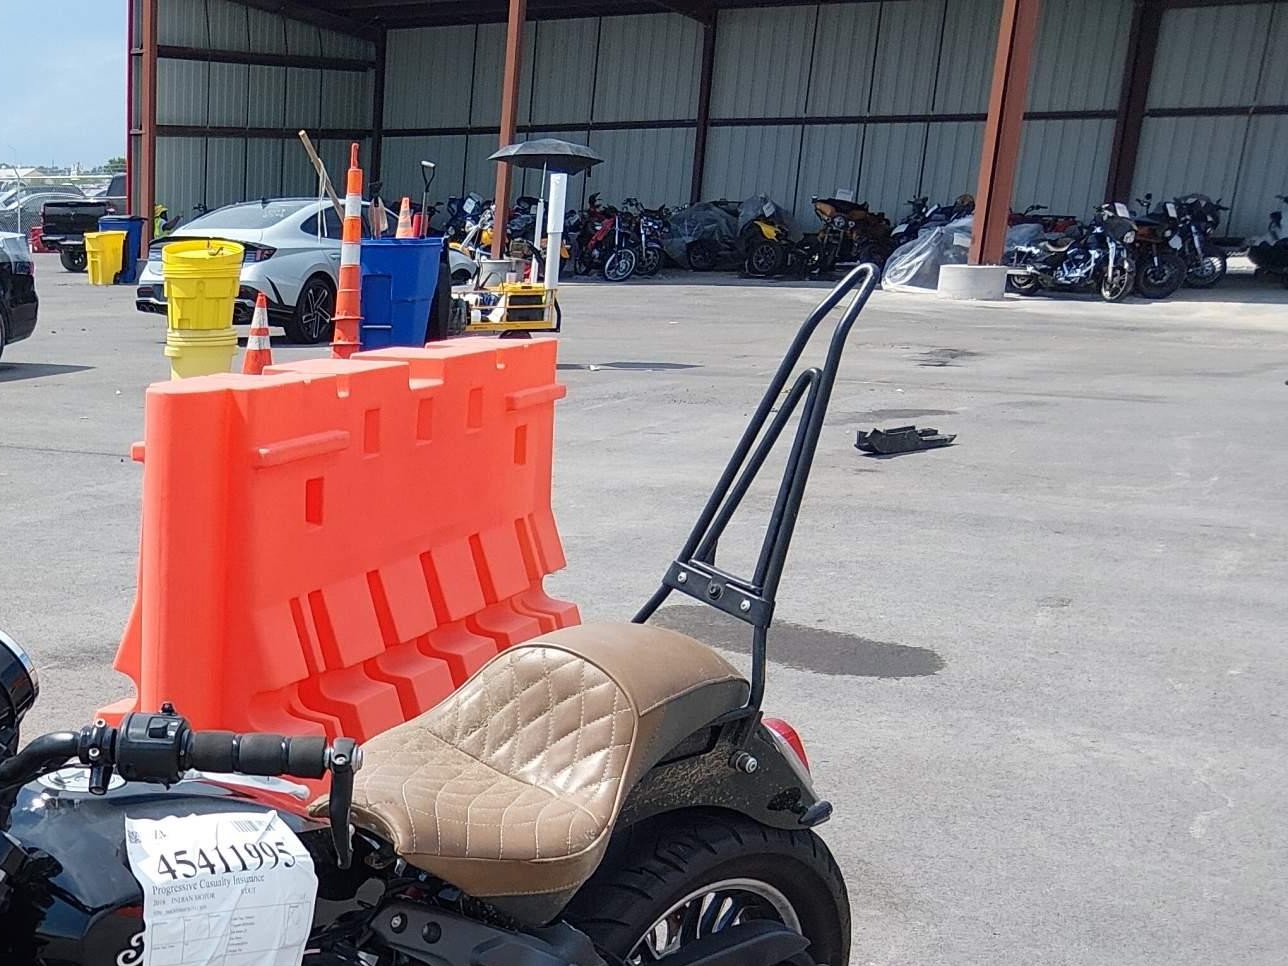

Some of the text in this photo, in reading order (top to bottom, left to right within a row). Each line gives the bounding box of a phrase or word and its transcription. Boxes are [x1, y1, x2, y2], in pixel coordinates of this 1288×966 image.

[158, 841, 296, 880] 45411995
[152, 882, 199, 897] Progressive
[199, 877, 231, 890] Casualty
